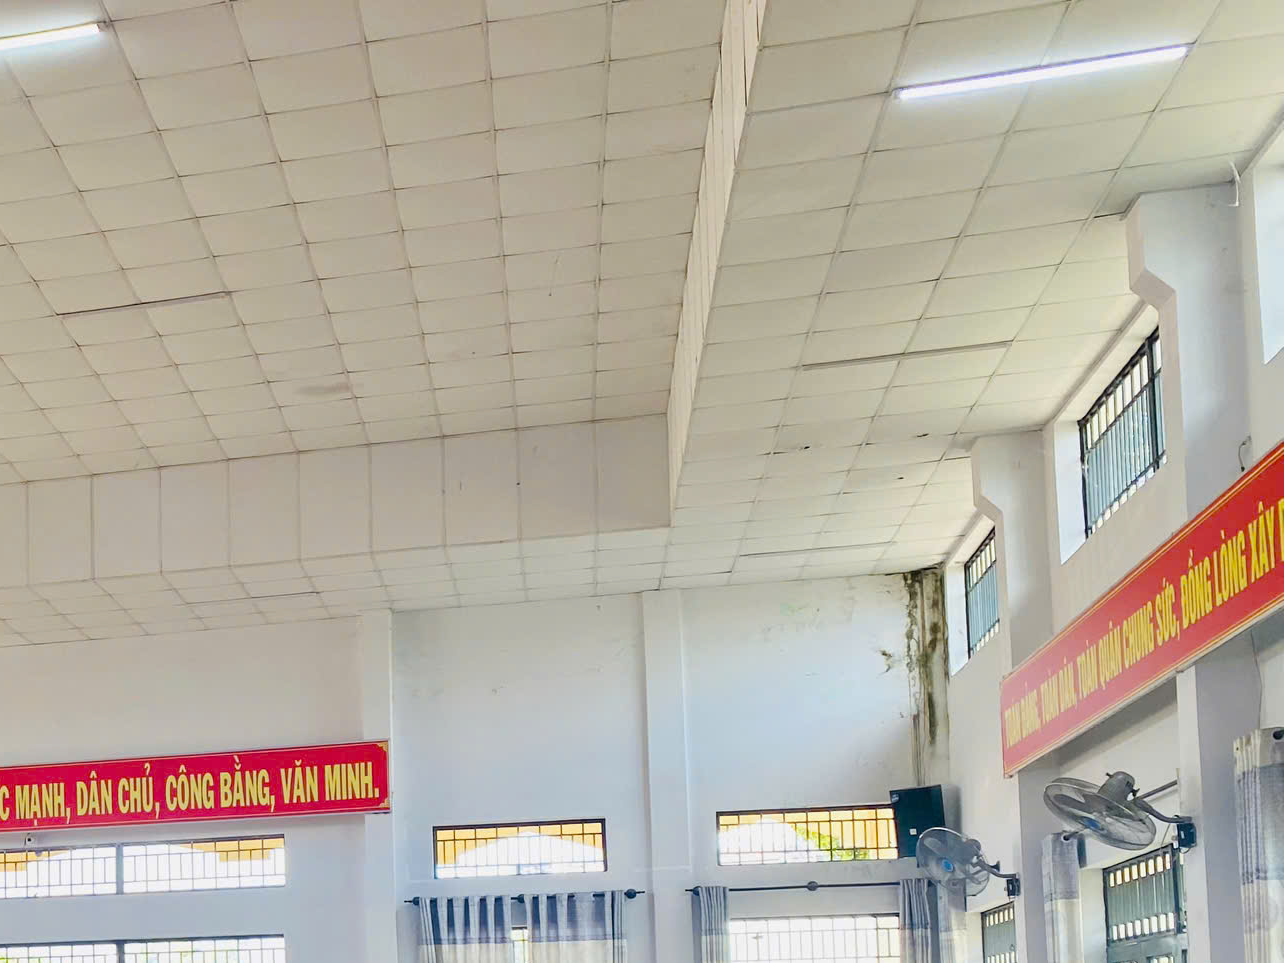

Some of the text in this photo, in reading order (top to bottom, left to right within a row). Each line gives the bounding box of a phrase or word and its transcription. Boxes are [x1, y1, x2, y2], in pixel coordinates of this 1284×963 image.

[1123, 601, 1154, 669] CHUNG
[1156, 578, 1180, 646] SỨC,
[1180, 549, 1212, 629] ĐỒNG
[1213, 529, 1248, 607] LÒNG
[1248, 501, 1275, 583] XÂY
[15, 783, 70, 826] MẠNH,
[76, 771, 112, 816] DÂN
[118, 762, 160, 819] CHỦ,
[166, 765, 214, 811] CÔNG
[220, 756, 275, 813] BẰNG,
[280, 760, 318, 804] VĂN
[325, 762, 379, 801] MINH.
